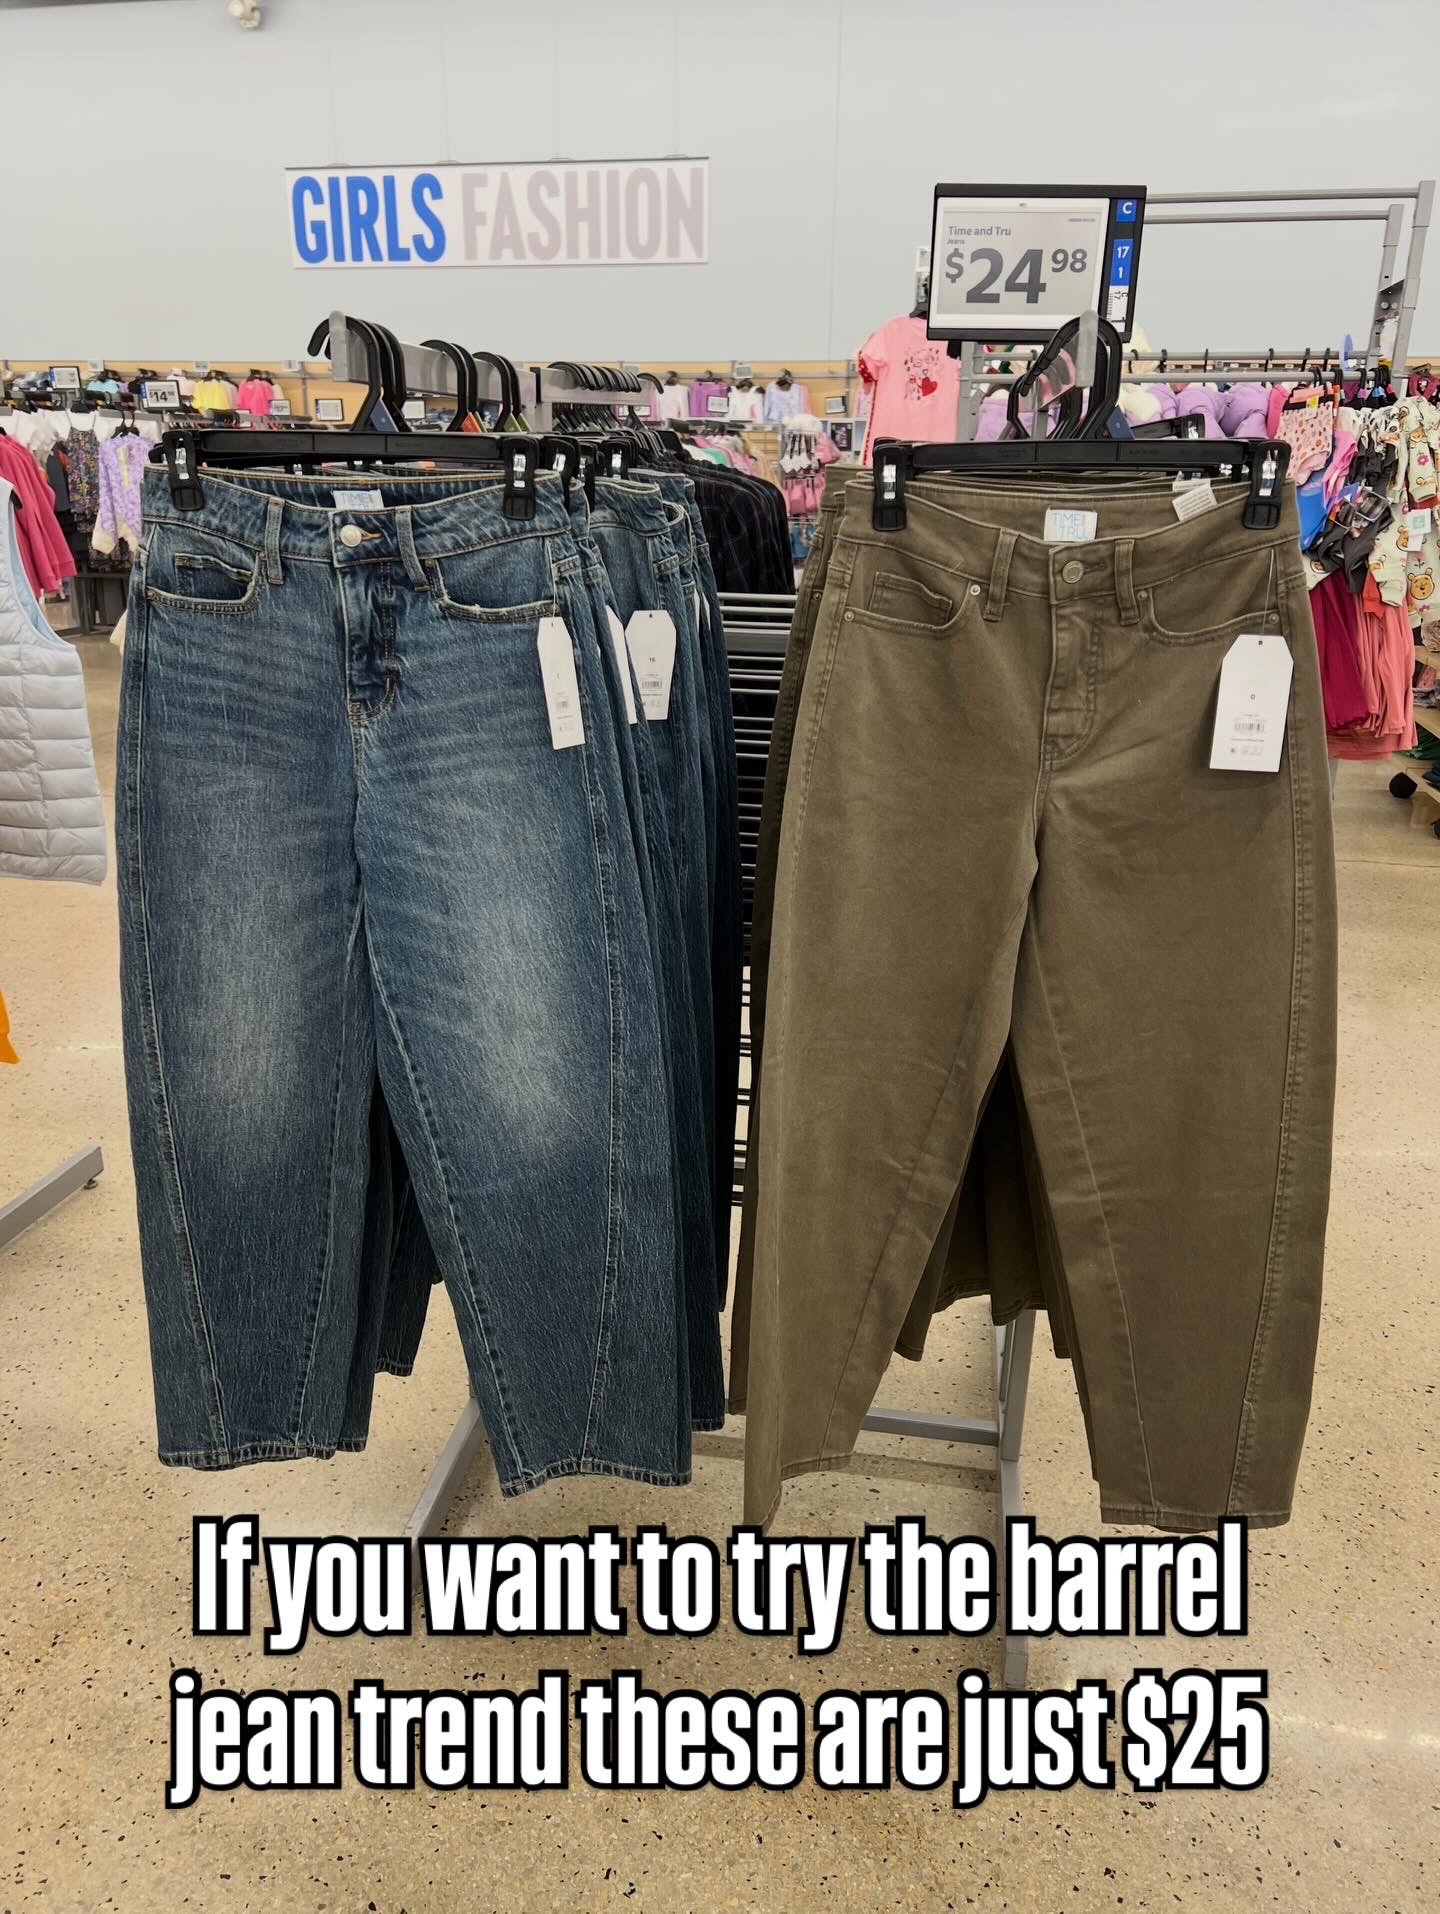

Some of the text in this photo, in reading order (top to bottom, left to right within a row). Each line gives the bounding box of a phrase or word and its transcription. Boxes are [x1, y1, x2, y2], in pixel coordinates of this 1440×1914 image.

[1122, 201, 1133, 215] C
[291, 166, 705, 265] GIRLS FASHION
[947, 225, 1012, 236] Time and Tru
[945, 237, 966, 246] Jeans
[1117, 246, 1130, 259] 17
[1117, 266, 1124, 279] 1
[1051, 512, 1081, 527] TIME
